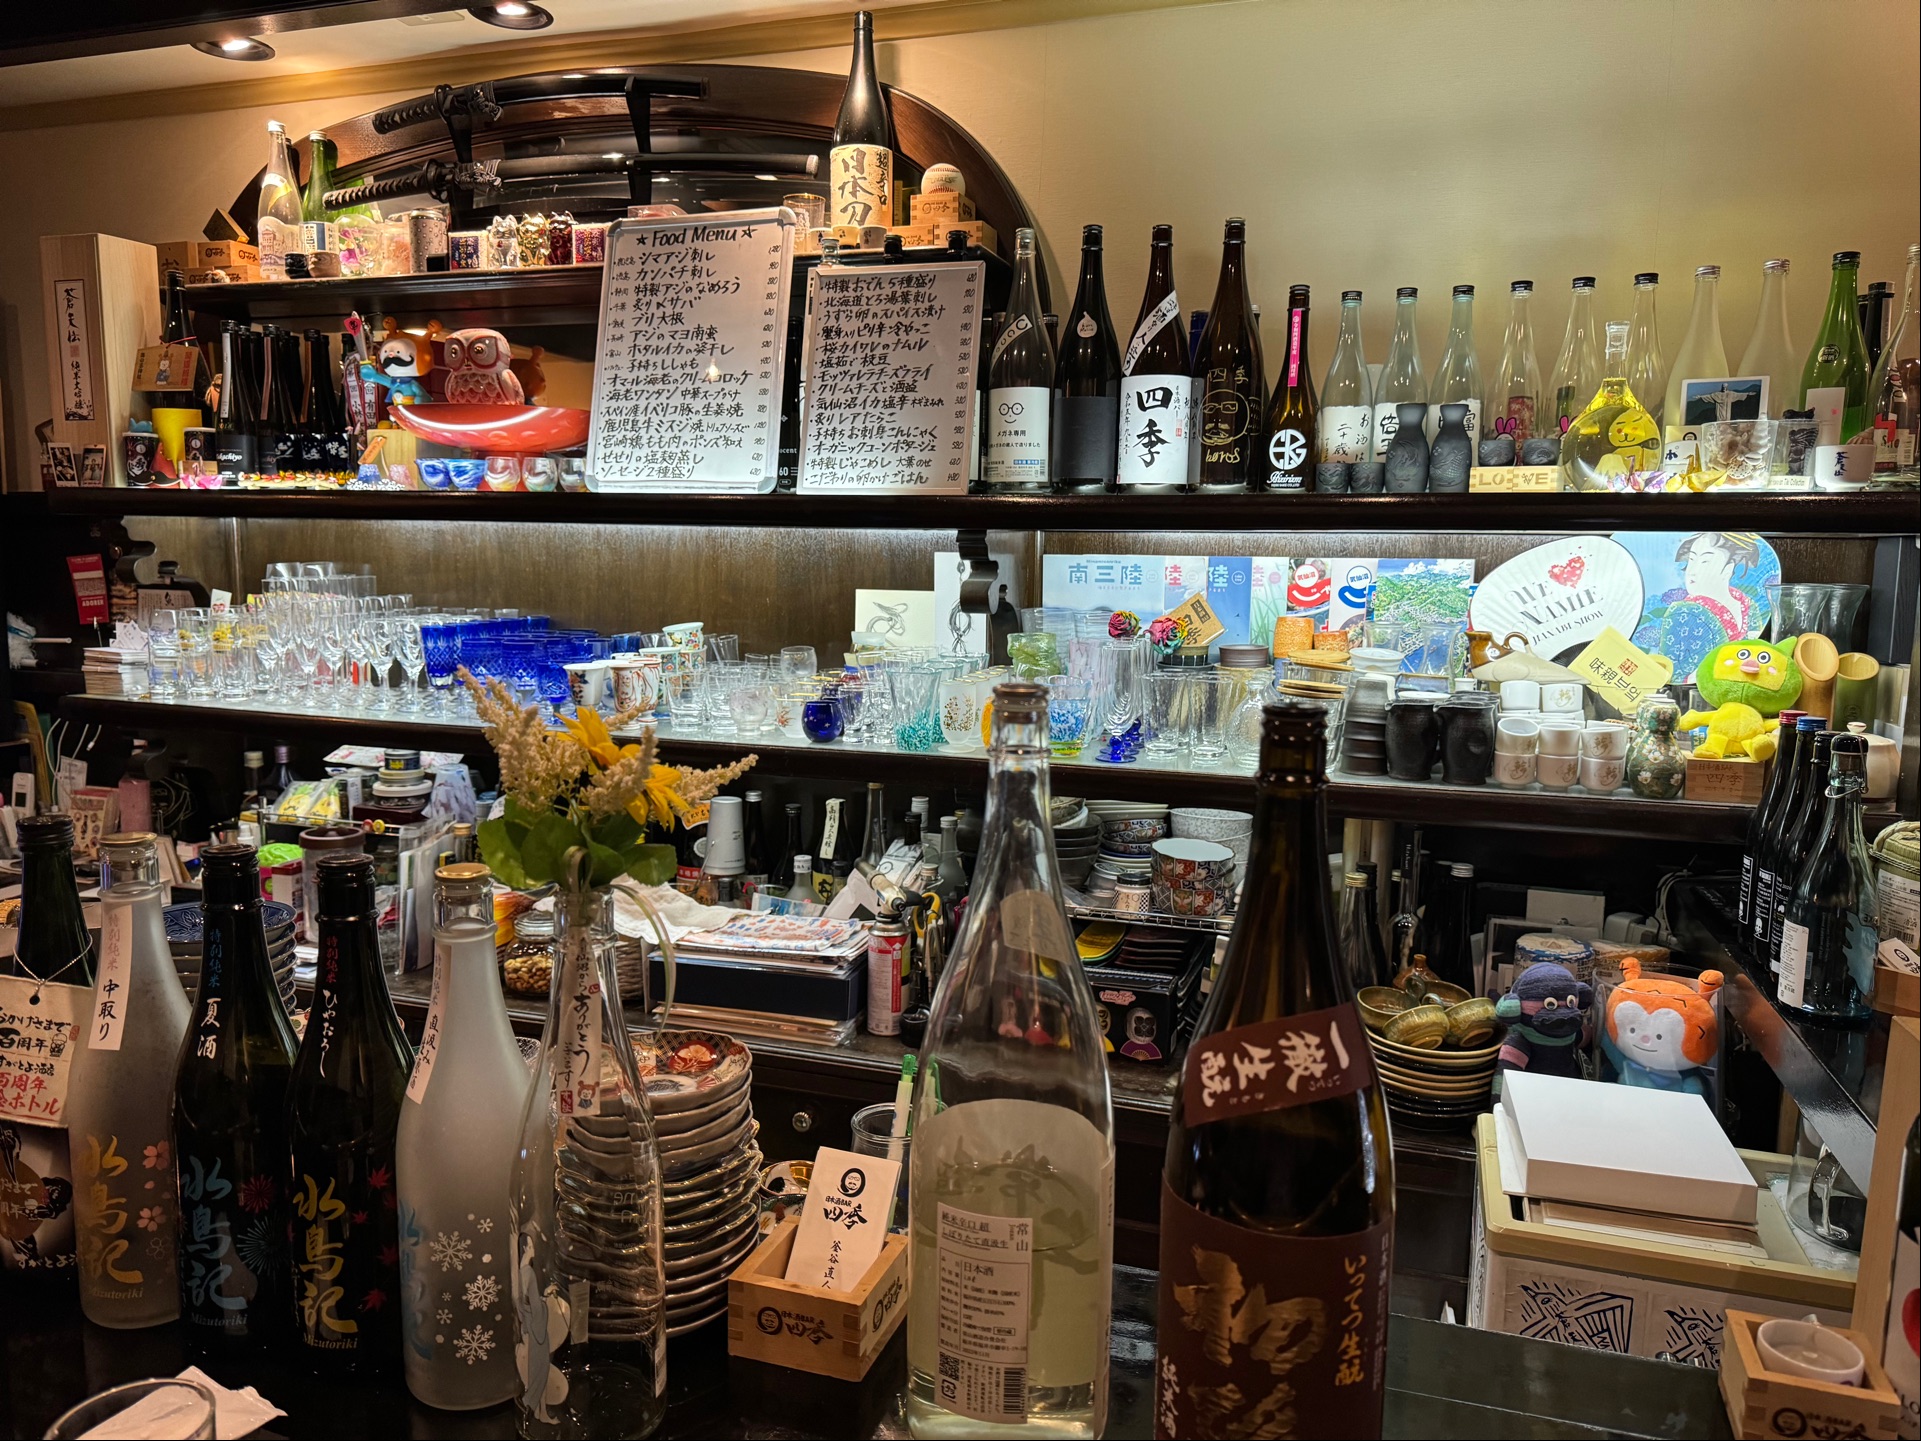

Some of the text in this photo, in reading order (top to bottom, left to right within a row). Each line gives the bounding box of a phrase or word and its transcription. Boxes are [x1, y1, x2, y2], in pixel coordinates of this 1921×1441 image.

[651, 226, 737, 247] Food Menu
[632, 311, 685, 327] ブリ大根
[1132, 386, 1174, 468] 四季
[1068, 563, 1143, 585] 南三陸
[1297, 571, 1316, 581] 気仙沼
[1350, 573, 1369, 583] 気仙沼
[1574, 610, 1604, 627] SHOW
[98, 979, 120, 1041] 中取り
[197, 998, 221, 1059] 夏酒
[319, 988, 338, 1078] ひやおろし
[573, 993, 592, 1077] ありがとう
[825, 1196, 852, 1207] 日本酒BAR
[823, 1203, 868, 1231] 四季
[1016, 1222, 1029, 1251] 常山
[821, 1240, 842, 1290] 釜谷直人
[963, 1261, 994, 1277] 日本酒
[781, 1310, 815, 1325] 日本酒BAR
[1335, 1254, 1367, 1387] いってつ生酛
[786, 1318, 834, 1346] 四季
